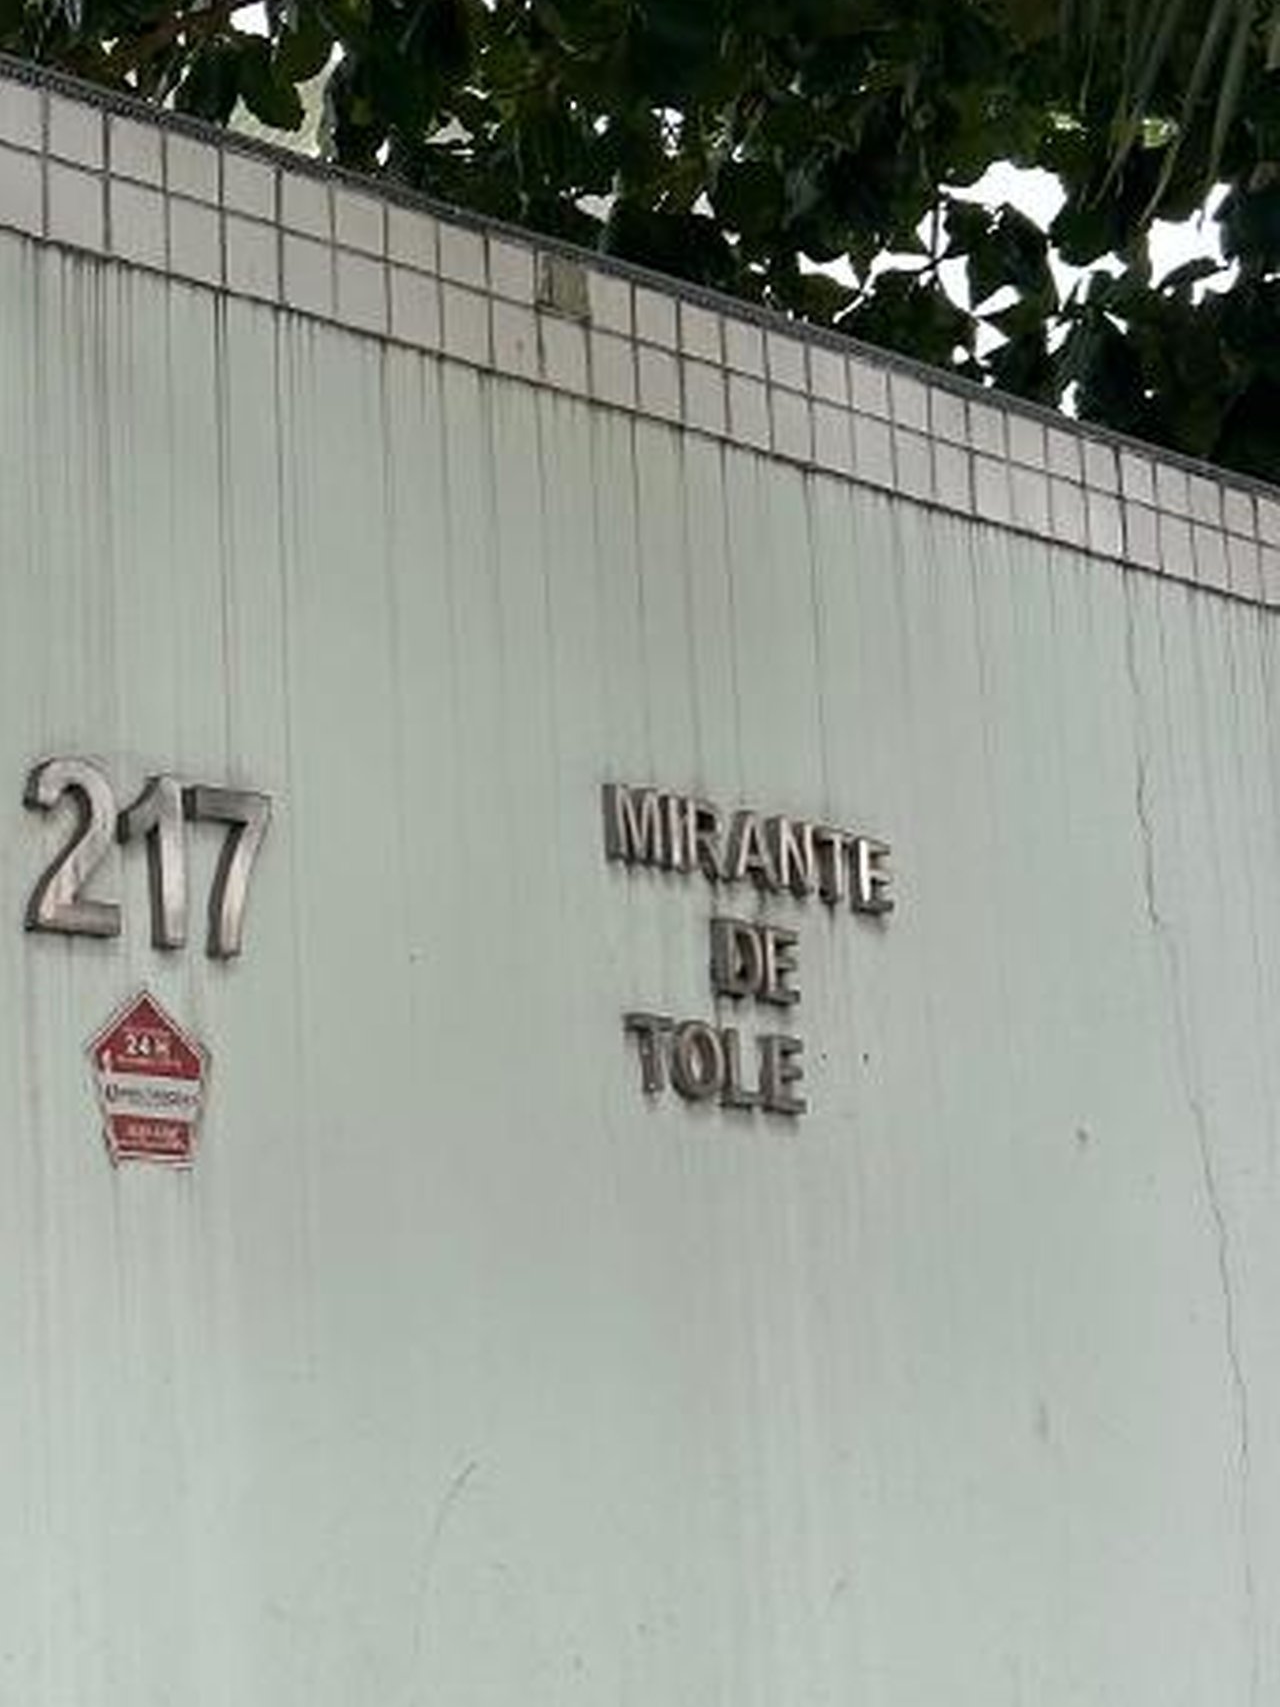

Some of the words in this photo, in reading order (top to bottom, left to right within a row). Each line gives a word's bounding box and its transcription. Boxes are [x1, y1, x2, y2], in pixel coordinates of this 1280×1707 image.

[23, 754, 273, 959] 217
[600, 782, 895, 915] MIRANTE
[710, 916, 801, 1006] DE
[624, 1011, 807, 1117] TOLE
